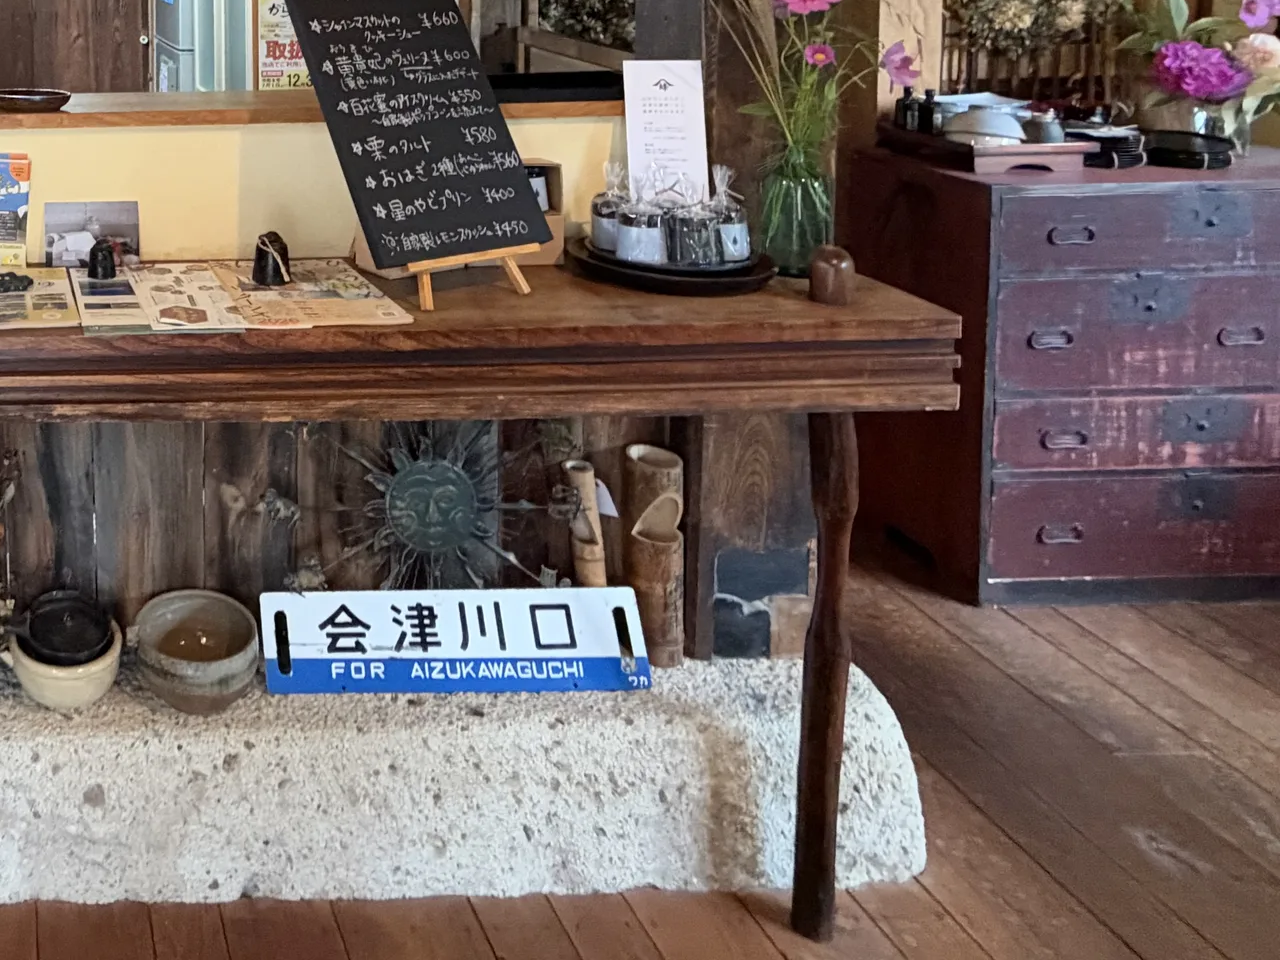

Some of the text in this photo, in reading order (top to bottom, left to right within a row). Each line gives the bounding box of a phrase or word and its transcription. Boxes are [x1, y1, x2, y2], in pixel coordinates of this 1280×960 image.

[418, 11, 459, 29] ¥660
[432, 49, 471, 65] ¥600
[448, 89, 482, 104] ¥550
[364, 126, 498, 162] 栗のタルト ¥580
[388, 187, 515, 221] 星のやどプリン ¥400
[493, 220, 529, 238] ¥450
[317, 601, 579, 654] 会津川口
[331, 659, 585, 681] FOR AIZUKAWAGUCHI
